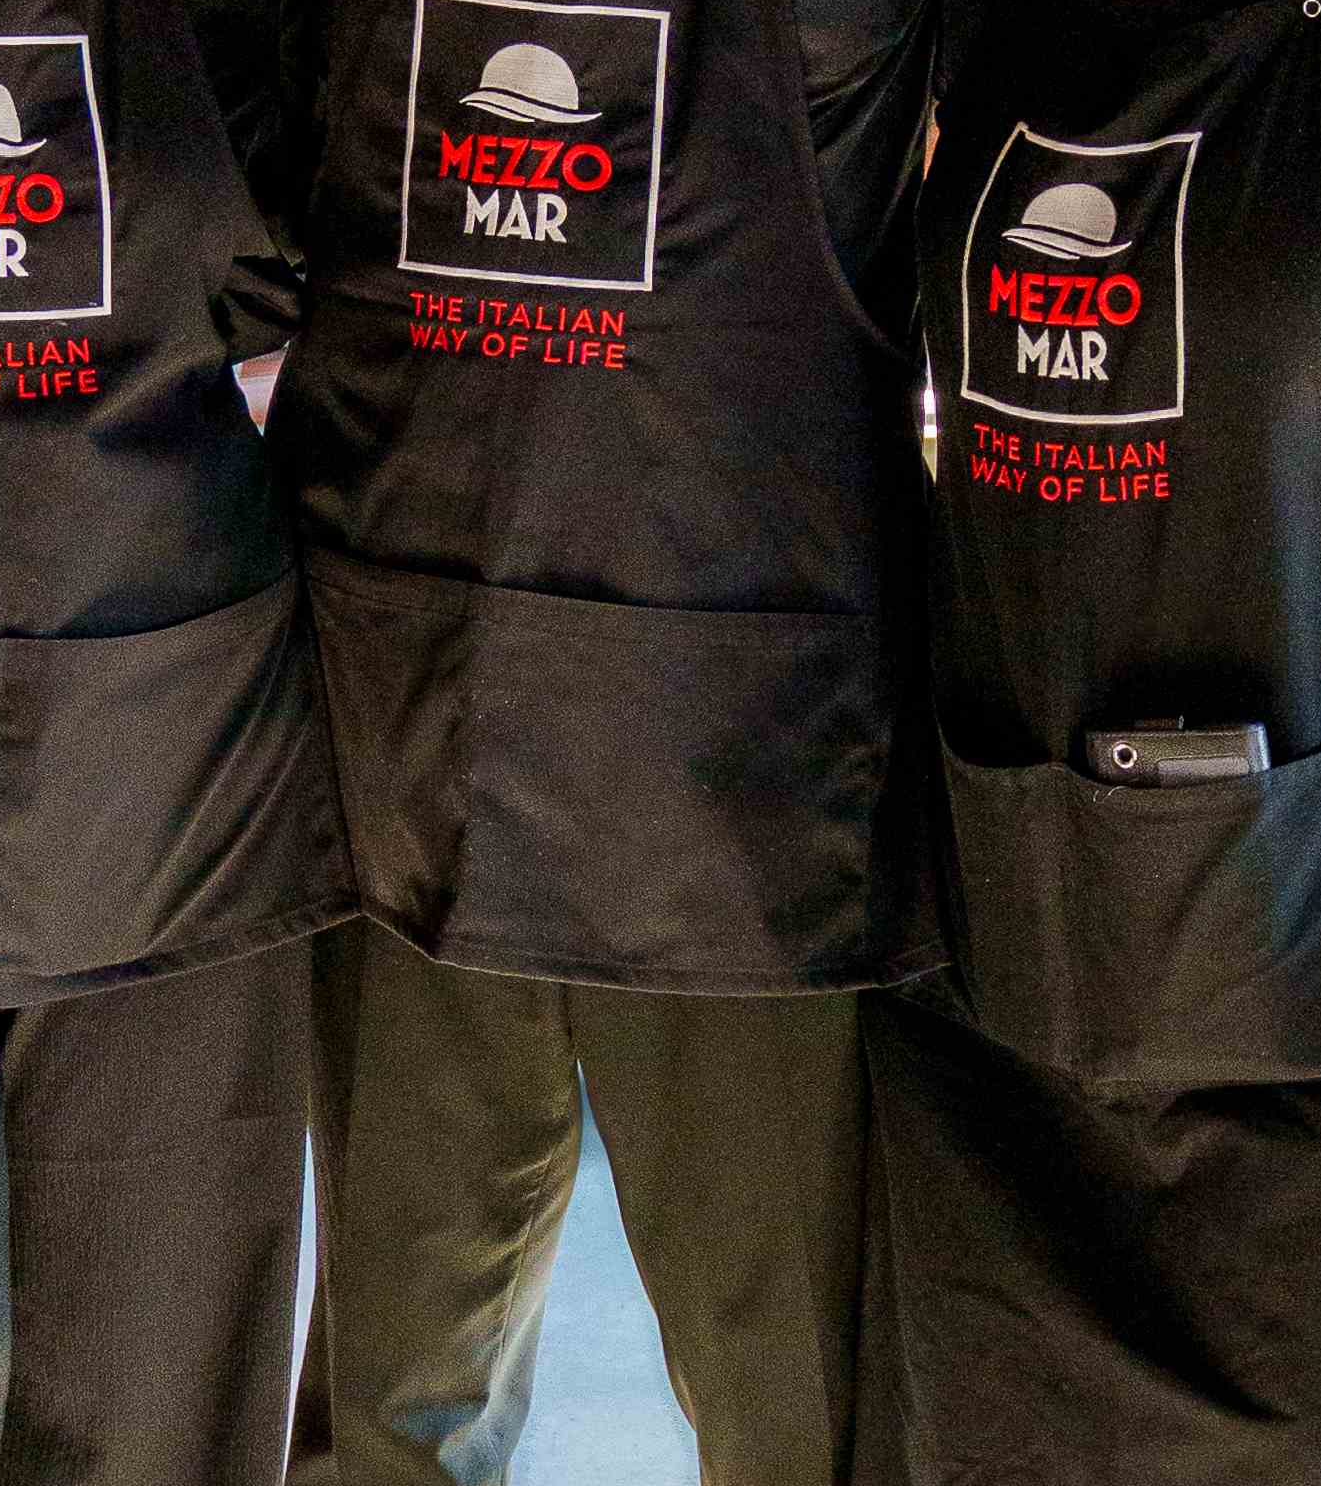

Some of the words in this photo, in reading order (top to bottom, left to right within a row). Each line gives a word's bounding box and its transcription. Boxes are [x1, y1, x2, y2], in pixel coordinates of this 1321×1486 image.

[439, 130, 613, 191] MEZZO
[463, 186, 568, 243] MAR
[410, 291, 463, 322] THE
[476, 299, 625, 336] ITALIAN
[989, 264, 1142, 326] MEZZO
[410, 324, 468, 353] WAY
[482, 331, 529, 359] OF
[543, 336, 627, 369] LIFE
[1017, 324, 1110, 381] MAR
[17, 368, 99, 398] LIFE
[973, 423, 1021, 461] THE
[1034, 440, 1166, 470] ITALIAN
[972, 454, 1027, 493] WAY
[1039, 475, 1085, 502] OF
[1099, 471, 1170, 502] LIFE
